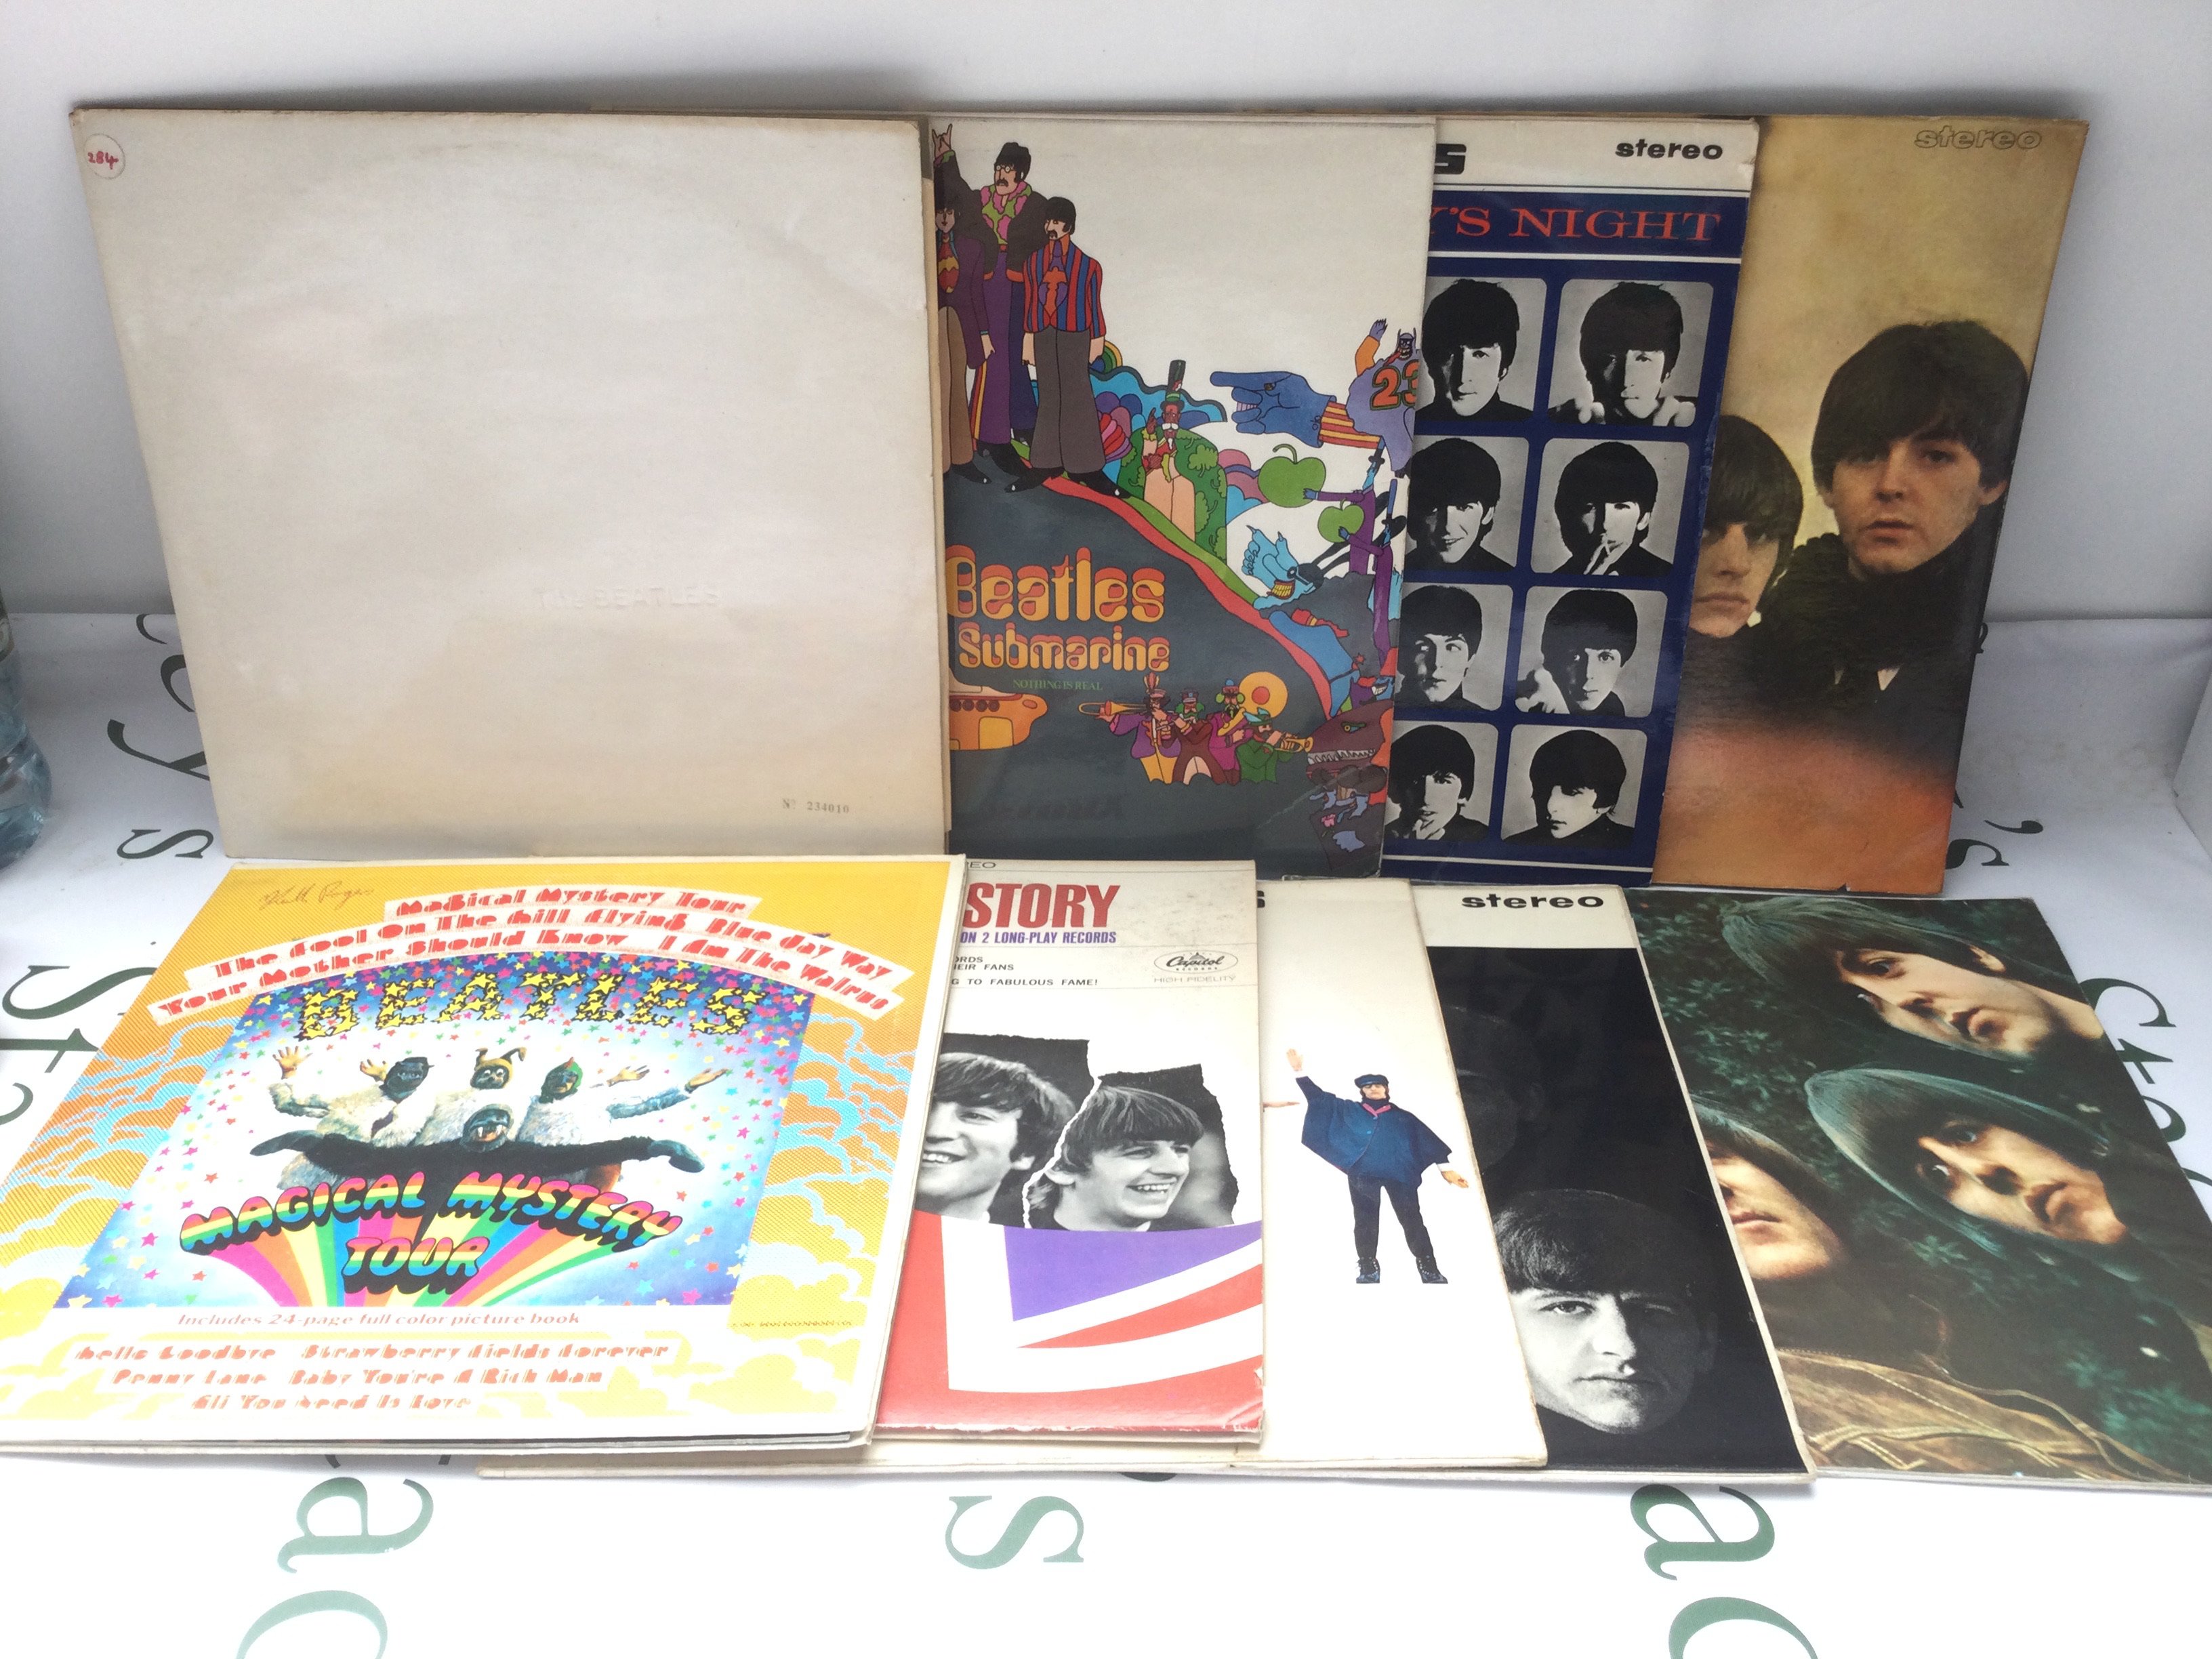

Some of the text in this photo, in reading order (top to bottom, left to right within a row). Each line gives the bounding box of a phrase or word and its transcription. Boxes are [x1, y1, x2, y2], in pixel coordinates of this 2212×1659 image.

[1615, 138, 1723, 160] stereo
[1914, 125, 2042, 150] stereo
[87, 150, 119, 170] 284
[1509, 207, 1721, 241] NIGHT
[946, 544, 1166, 623] Beatles
[958, 621, 1170, 672] Submarine
[1012, 679, 1103, 691] NOTHING IS REAL
[396, 888, 746, 916] Magical Mystery Tour
[962, 882, 1121, 928] STORY
[1462, 893, 1604, 909] stereo
[211, 953, 279, 978] The
[377, 922, 426, 939] On
[434, 914, 497, 931] The
[705, 918, 772, 942] Blue
[840, 950, 893, 981] Way
[960, 931, 1116, 943] ON 2 LONG-PLAY RECORDS
[158, 981, 247, 1016] Your
[260, 948, 394, 987] Mother
[405, 930, 526, 956] Should
[736, 947, 791, 972] The
[800, 964, 889, 1010] Walrus
[1166, 956, 1225, 967] Capitol
[295, 971, 767, 1042] BEATLES
[180, 1171, 684, 1255] MAGICAL MYSTERY
[342, 1236, 491, 1289] TOUR
[178, 1313, 580, 1327] Includes 24-page full color picture book
[301, 1344, 462, 1361] Strawberry
[111, 1369, 195, 1387] Penny
[289, 1369, 352, 1386] Baby
[480, 1368, 538, 1385] Rich
[546, 1368, 602, 1383] Man
